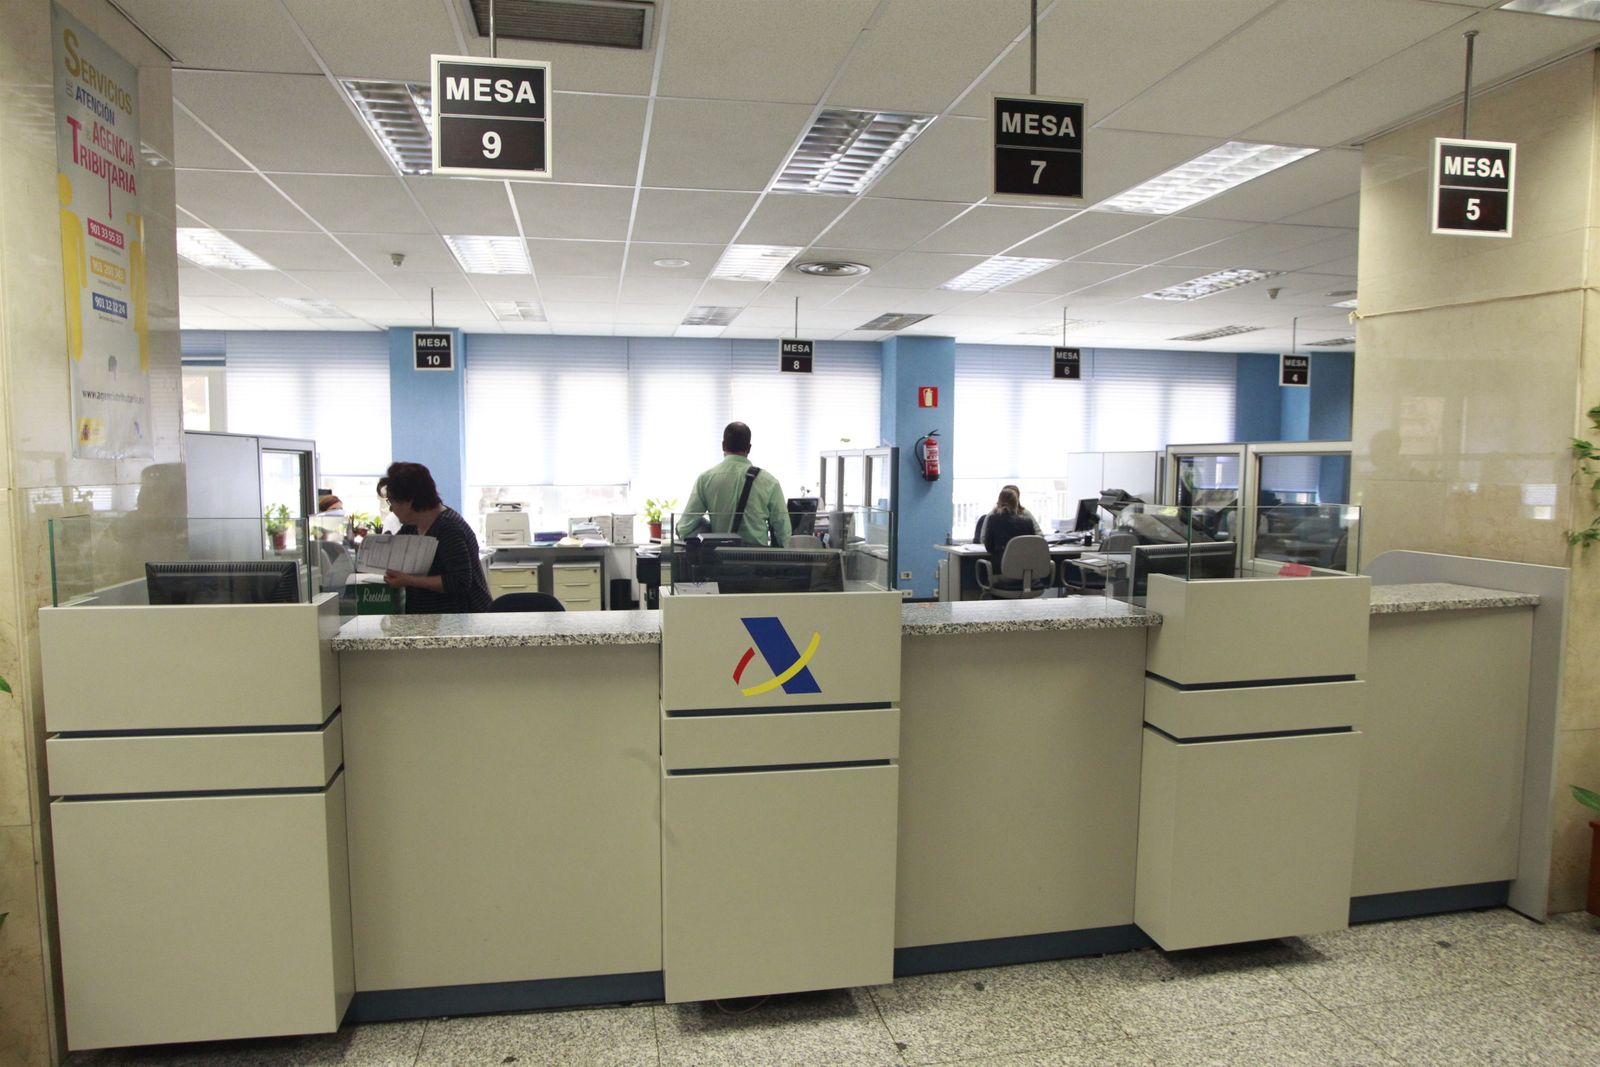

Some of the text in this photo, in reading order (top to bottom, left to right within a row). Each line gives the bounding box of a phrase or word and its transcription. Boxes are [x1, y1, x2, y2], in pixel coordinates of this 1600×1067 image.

[64, 28, 132, 115] SERVICIOS
[446, 77, 536, 104] MESA
[76, 86, 115, 126] ATENCIÓN
[1002, 112, 1076, 138] MESA
[66, 115, 137, 196] TRIBUTARIA
[93, 121, 135, 168] AGENCIA
[482, 131, 502, 159] 9
[1030, 160, 1047, 184] 7
[1444, 156, 1505, 178] MESA
[1466, 198, 1480, 220] 5
[417, 338, 448, 347] MESA
[783, 343, 811, 353] MESA
[426, 355, 441, 365] 10
[793, 360, 800, 370] 8
[1056, 351, 1079, 360] MESA
[1284, 359, 1307, 367] MESA
[1064, 366, 1071, 376] 6
